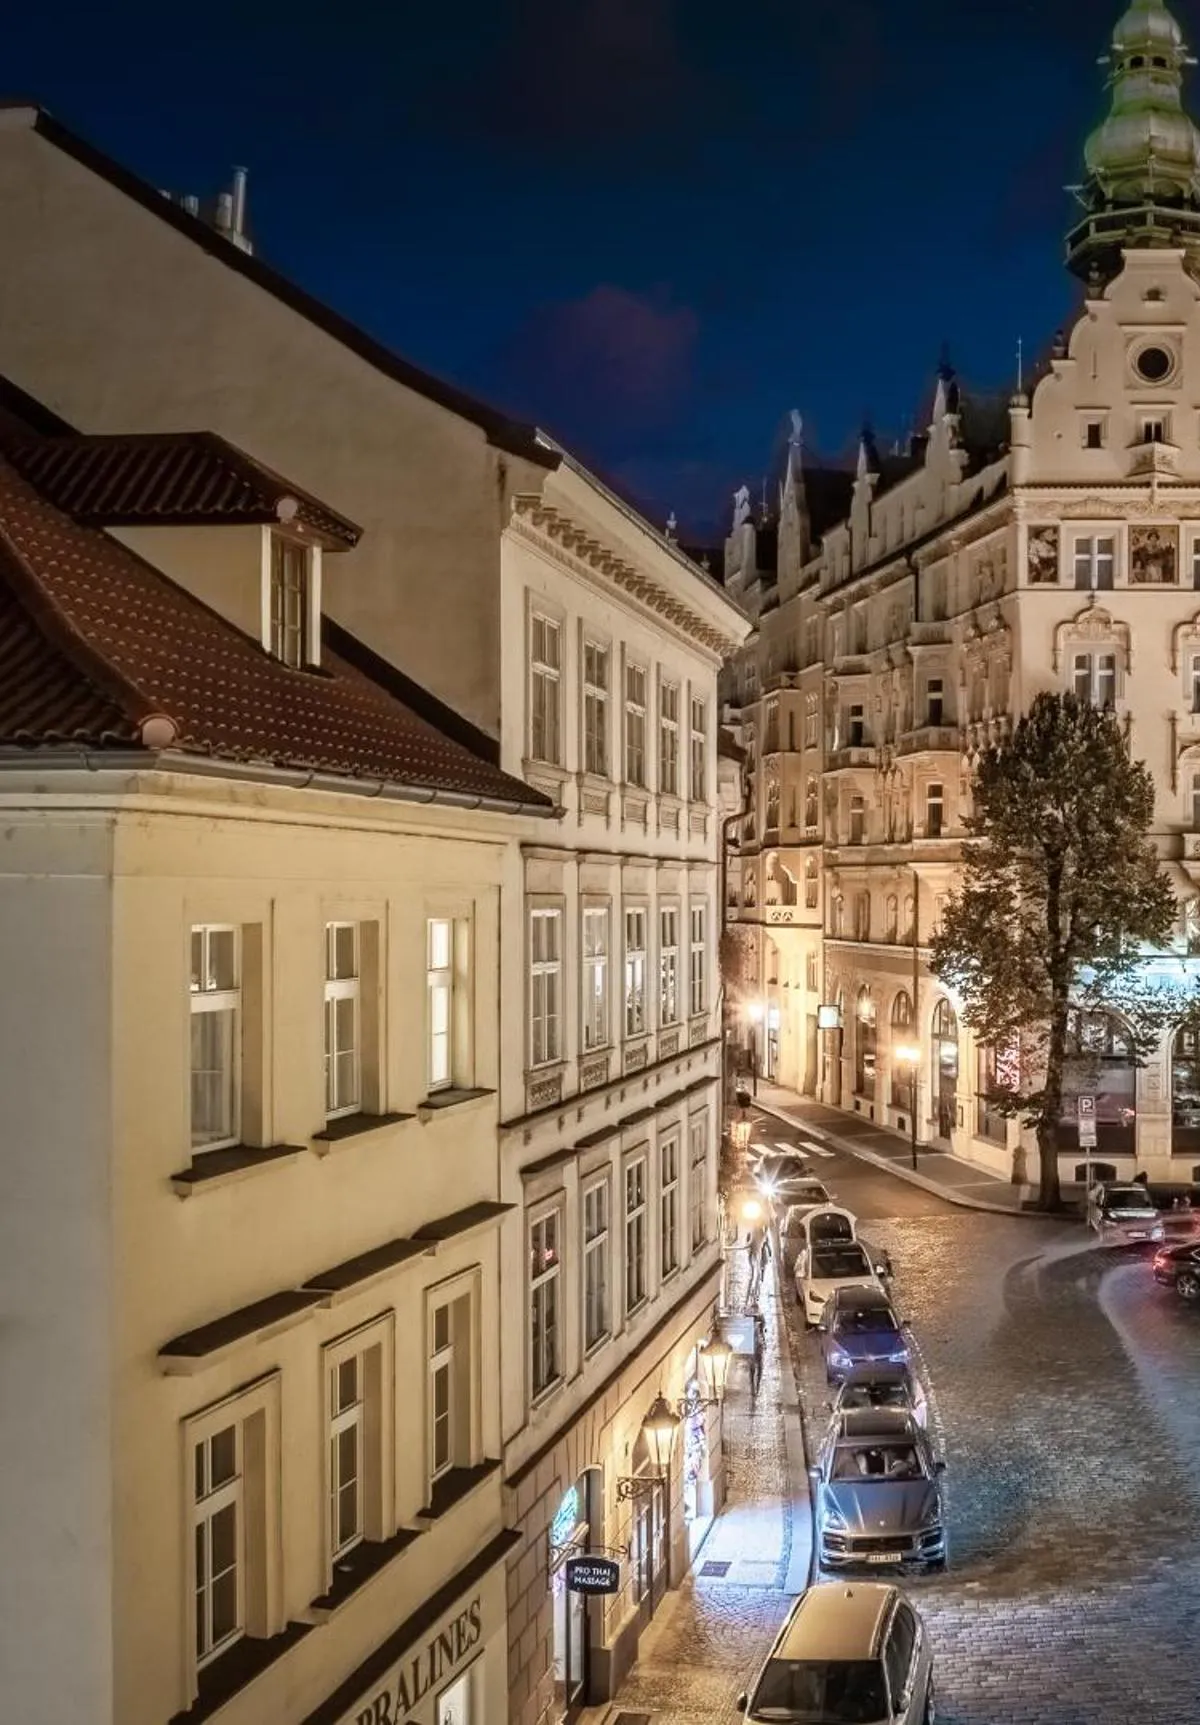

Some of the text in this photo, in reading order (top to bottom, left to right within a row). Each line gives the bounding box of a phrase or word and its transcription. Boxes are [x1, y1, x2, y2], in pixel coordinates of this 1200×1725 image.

[574, 1566, 611, 1577] PRO THAI
[574, 1575, 611, 1586] MASSAGE
